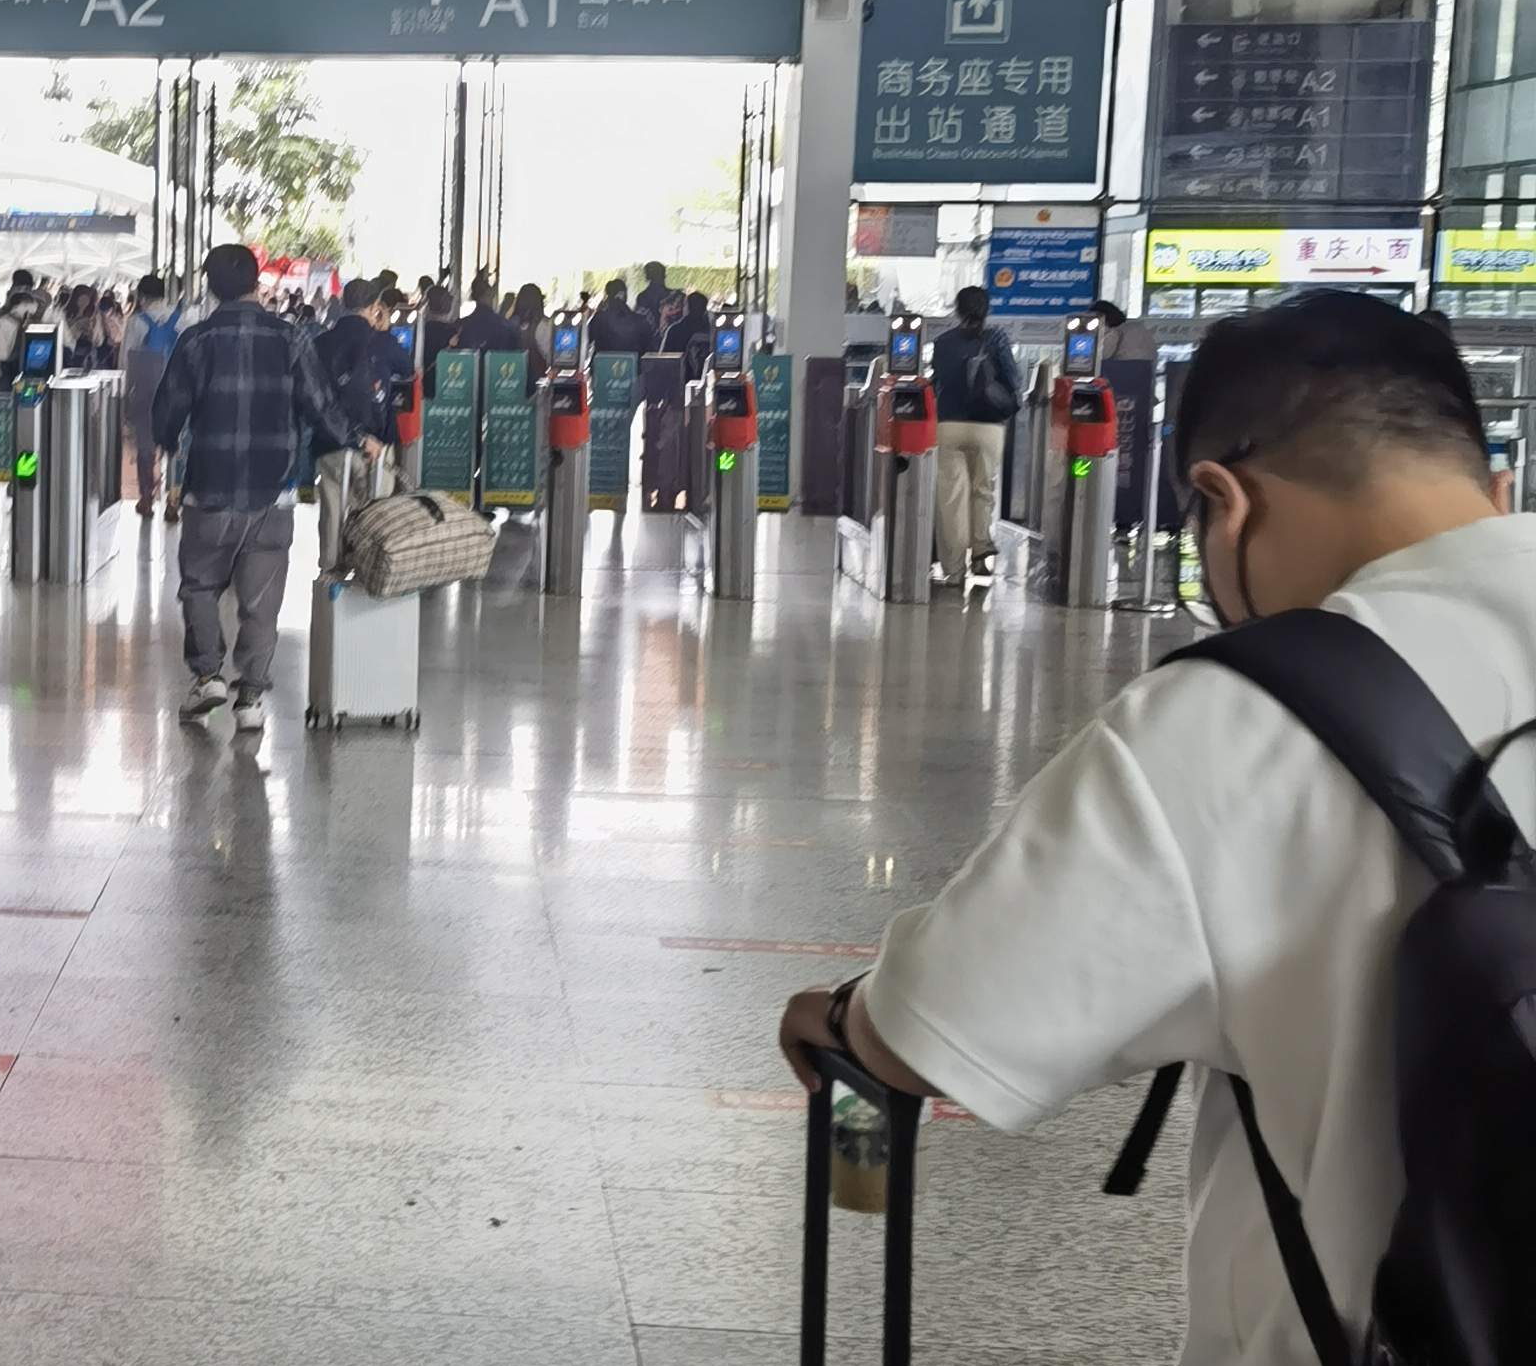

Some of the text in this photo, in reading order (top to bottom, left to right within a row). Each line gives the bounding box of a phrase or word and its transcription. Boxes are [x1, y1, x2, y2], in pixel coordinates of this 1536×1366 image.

[876, 55, 1074, 97] 商务座专用
[874, 103, 1072, 143] 出站通道
[1295, 236, 1413, 262] 重庆小面
